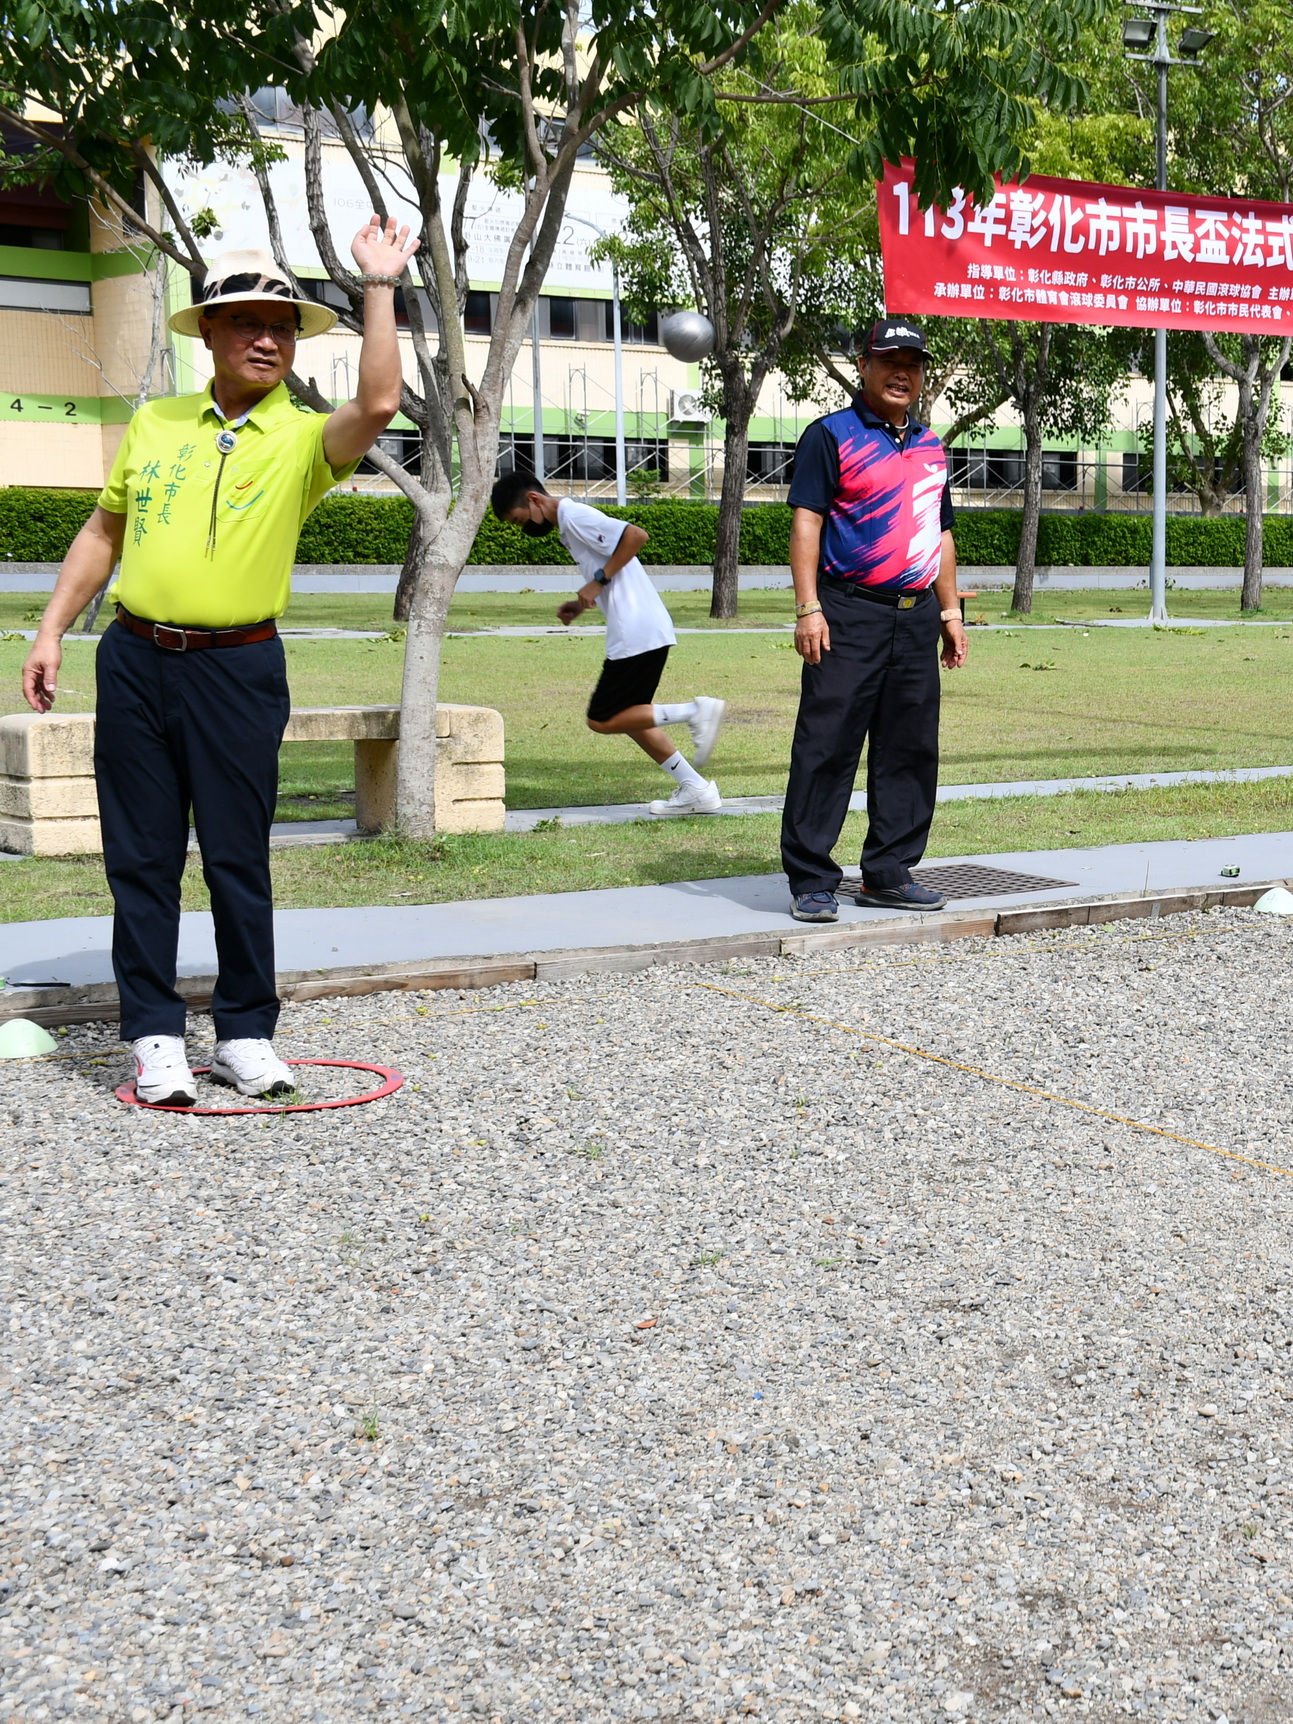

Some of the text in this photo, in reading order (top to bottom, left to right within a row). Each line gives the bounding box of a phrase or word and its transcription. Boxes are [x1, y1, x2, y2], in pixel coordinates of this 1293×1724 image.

[133, 460, 161, 547] 林世賢
[157, 443, 196, 525] 彰化市長
